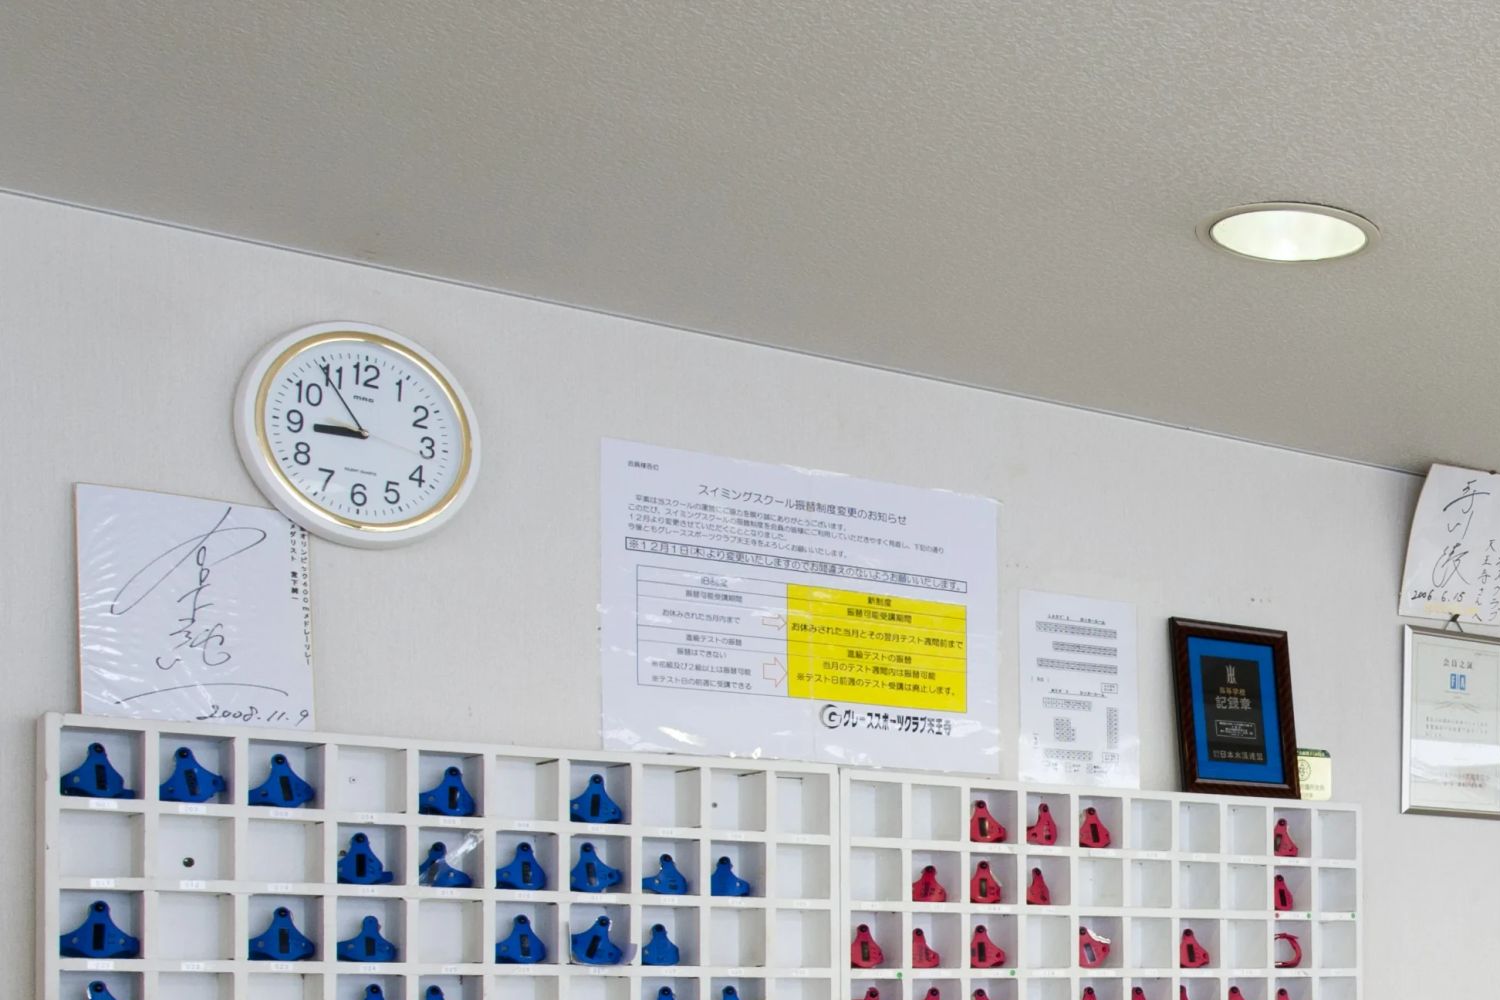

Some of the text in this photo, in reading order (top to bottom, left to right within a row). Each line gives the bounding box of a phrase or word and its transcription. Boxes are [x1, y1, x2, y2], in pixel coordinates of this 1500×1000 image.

[324, 363, 342, 390] 11
[353, 361, 380, 389] 12
[296, 379, 323, 407] 10
[395, 379, 403, 402] 1
[286, 409, 304, 433] 9
[412, 405, 429, 429] 2
[293, 441, 311, 466] 8
[419, 436, 435, 460] 3
[318, 467, 335, 492] 7
[408, 464, 426, 488] 4
[350, 483, 368, 507] 6
[383, 480, 400, 504] 5
